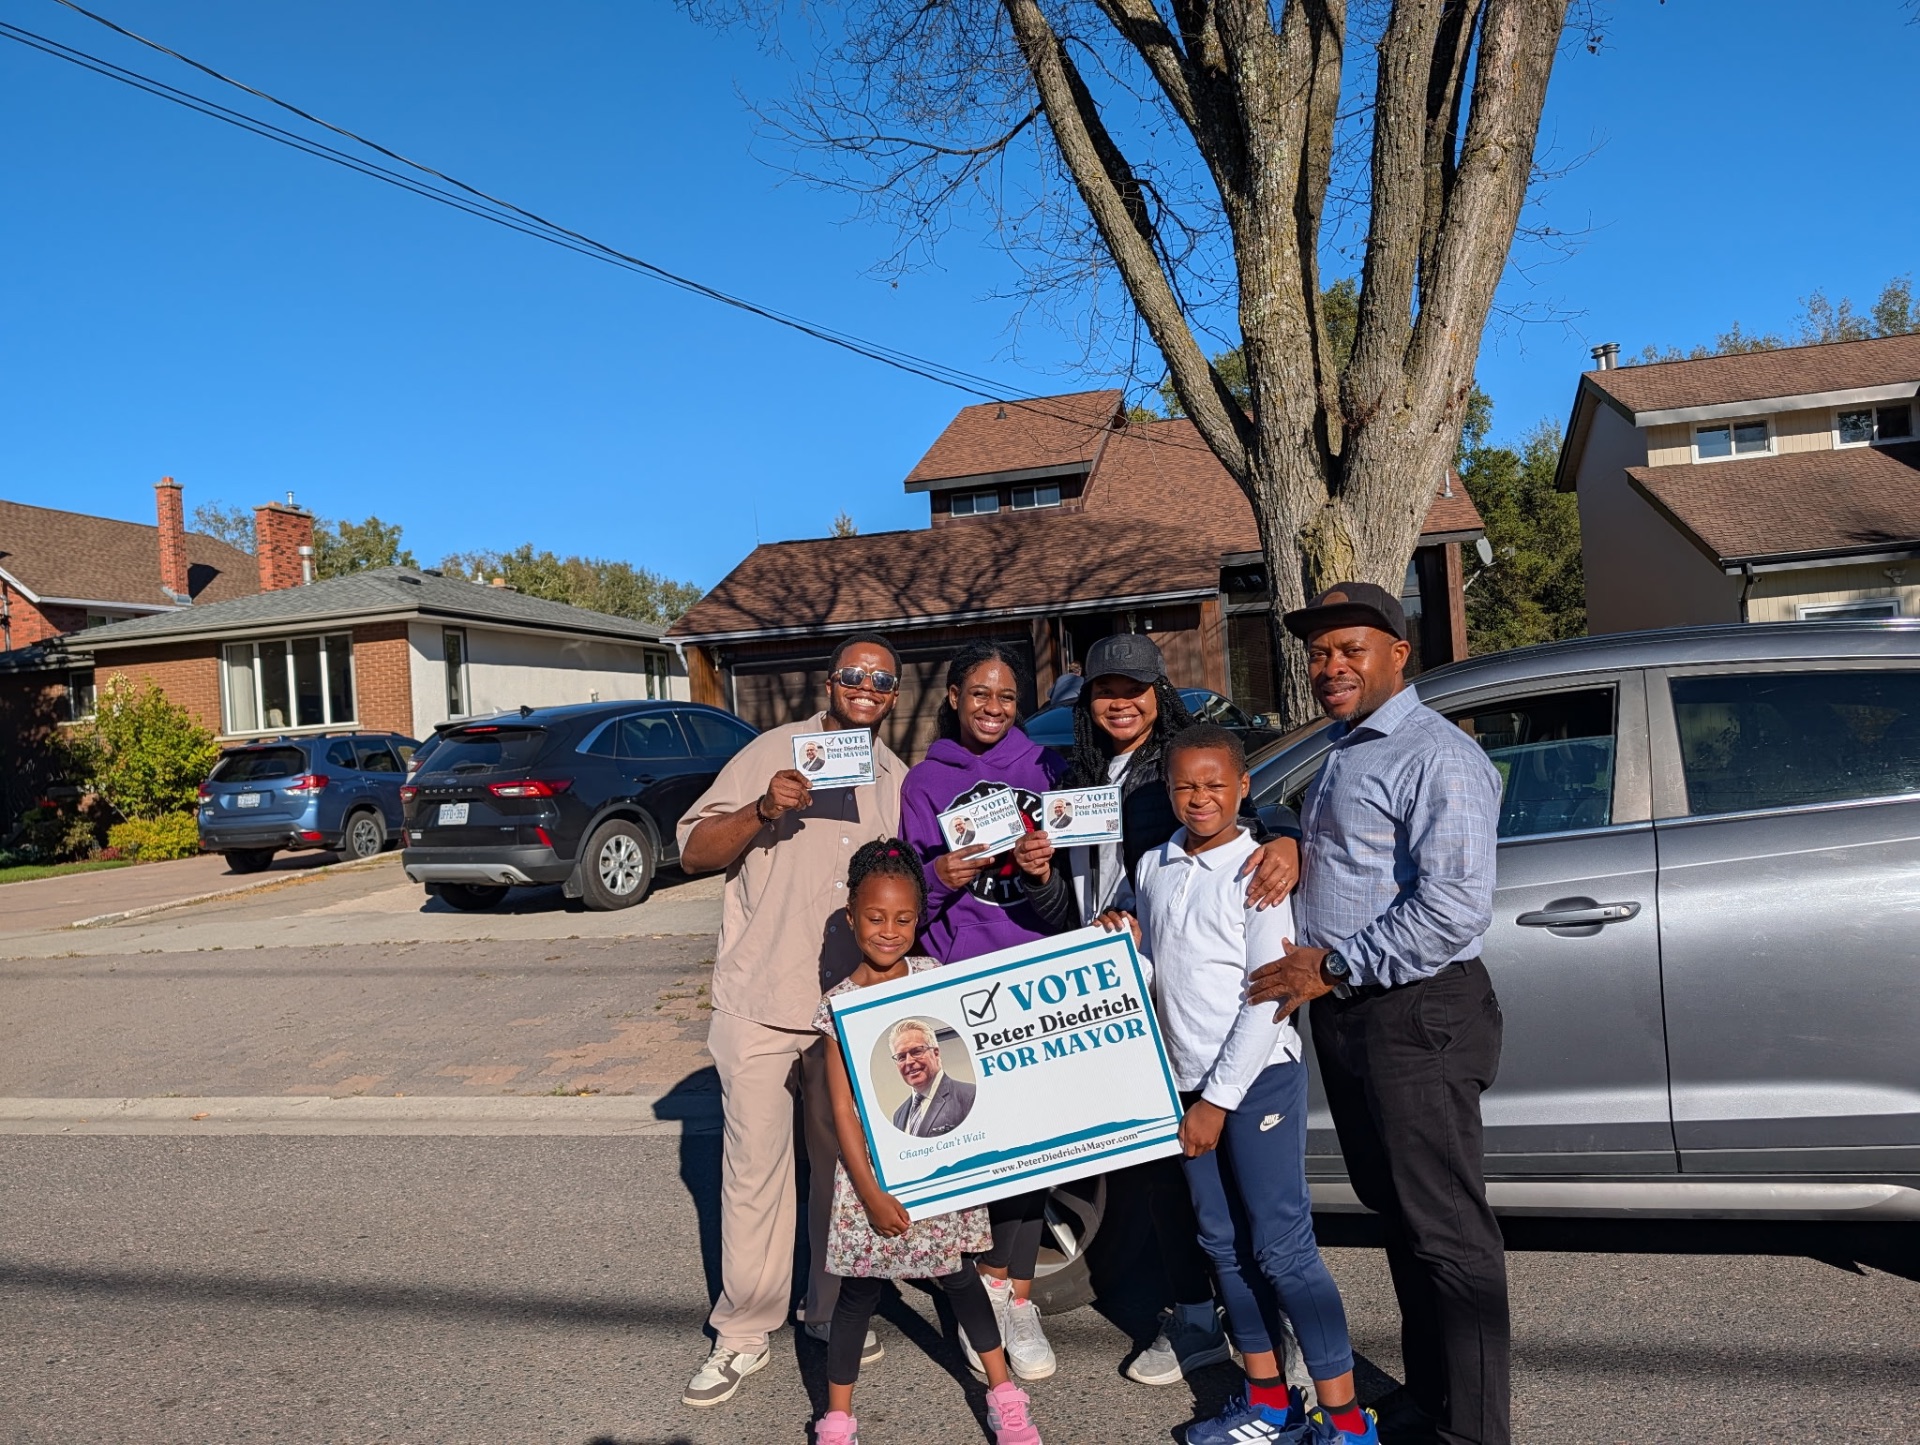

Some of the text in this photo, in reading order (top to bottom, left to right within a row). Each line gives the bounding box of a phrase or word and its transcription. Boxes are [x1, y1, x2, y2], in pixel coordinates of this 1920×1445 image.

[837, 735, 866, 745] VOTE
[981, 796, 1009, 811] VOTE
[1086, 792, 1116, 802] VOTE
[973, 813, 989, 823] Peter
[976, 810, 1016, 829] FOR MAYOR
[1091, 807, 1118, 815] MAYOR
[1007, 959, 1121, 1011] VOTE
[972, 993, 1140, 1050] Peter Diedrich
[979, 1018, 1147, 1077] FOR MAYOR
[899, 1131, 986, 1161] Change Can't Wait
[991, 1132, 1138, 1175] www.PeterDiedrich4Mayor.com
